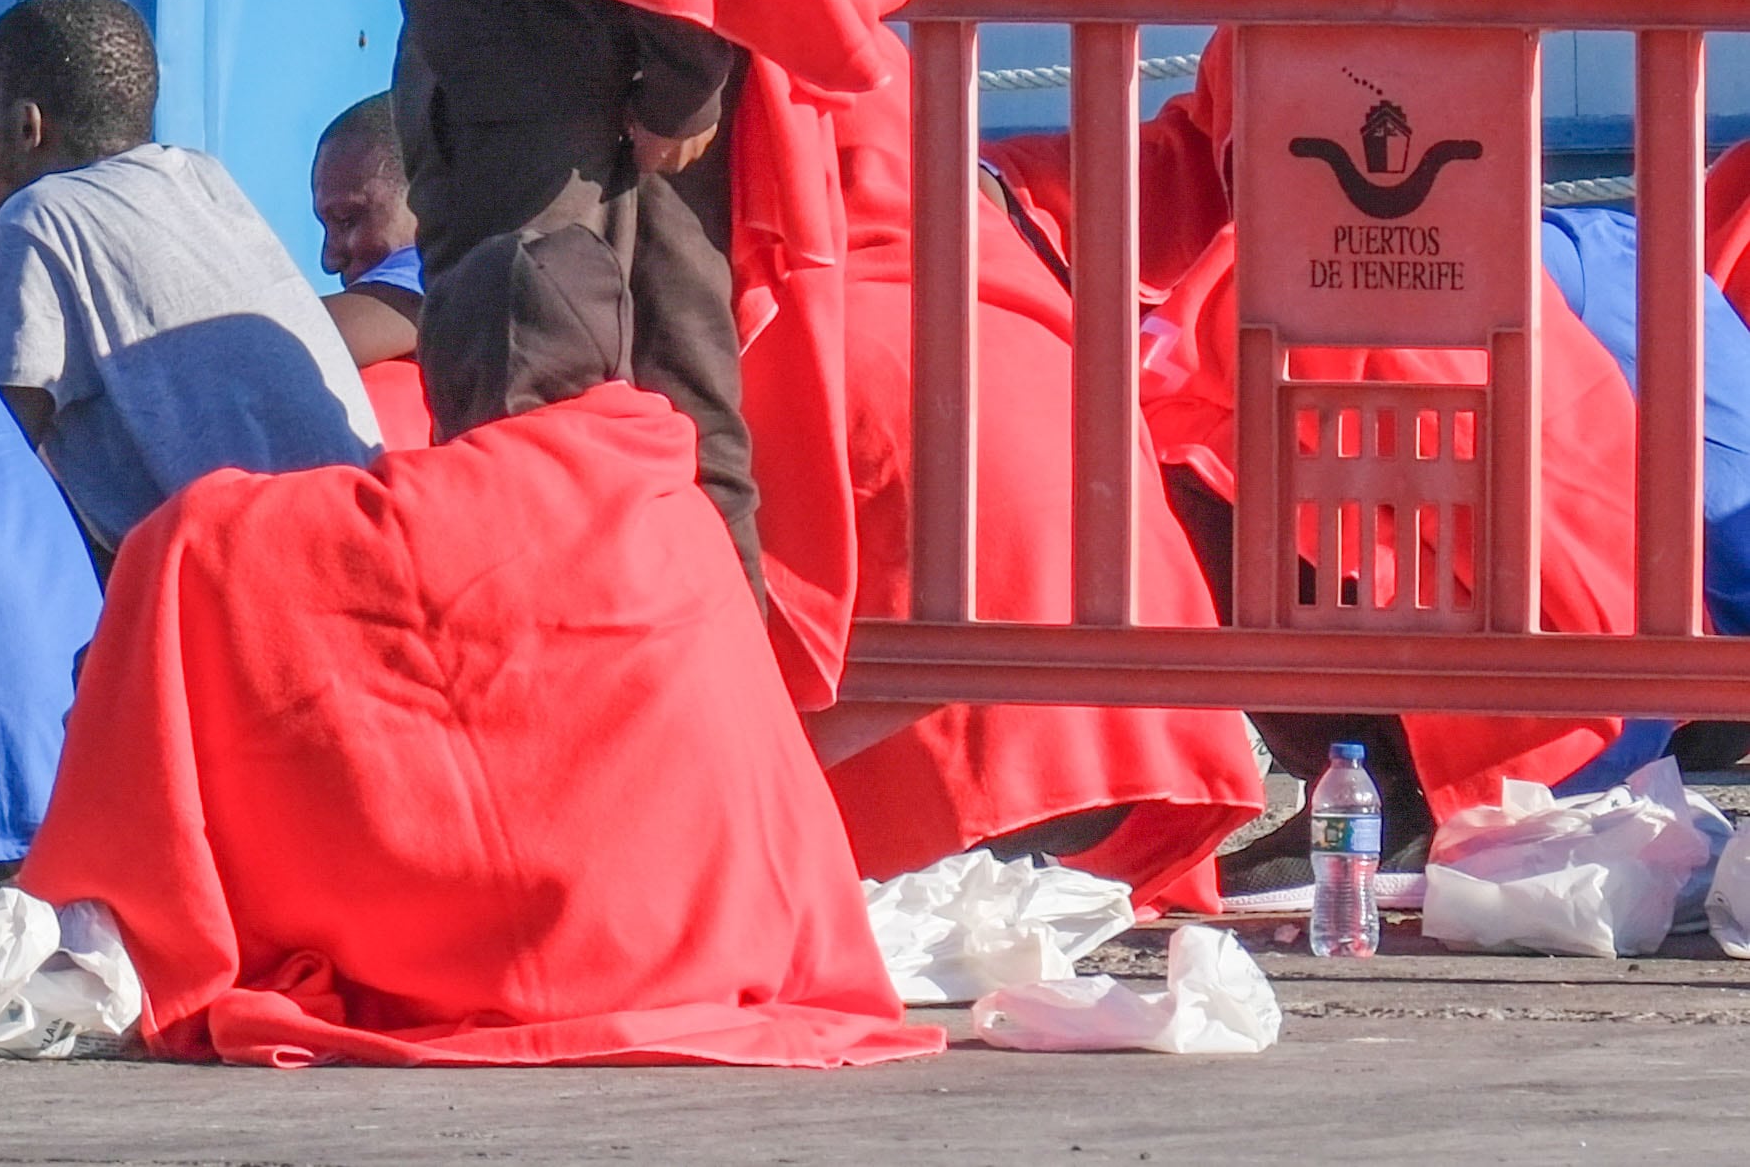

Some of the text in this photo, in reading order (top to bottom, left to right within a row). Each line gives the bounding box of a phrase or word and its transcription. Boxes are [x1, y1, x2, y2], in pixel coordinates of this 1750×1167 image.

[1333, 225, 1440, 255] PUERTOS
[1310, 259, 1465, 290] DE TENERIFE
